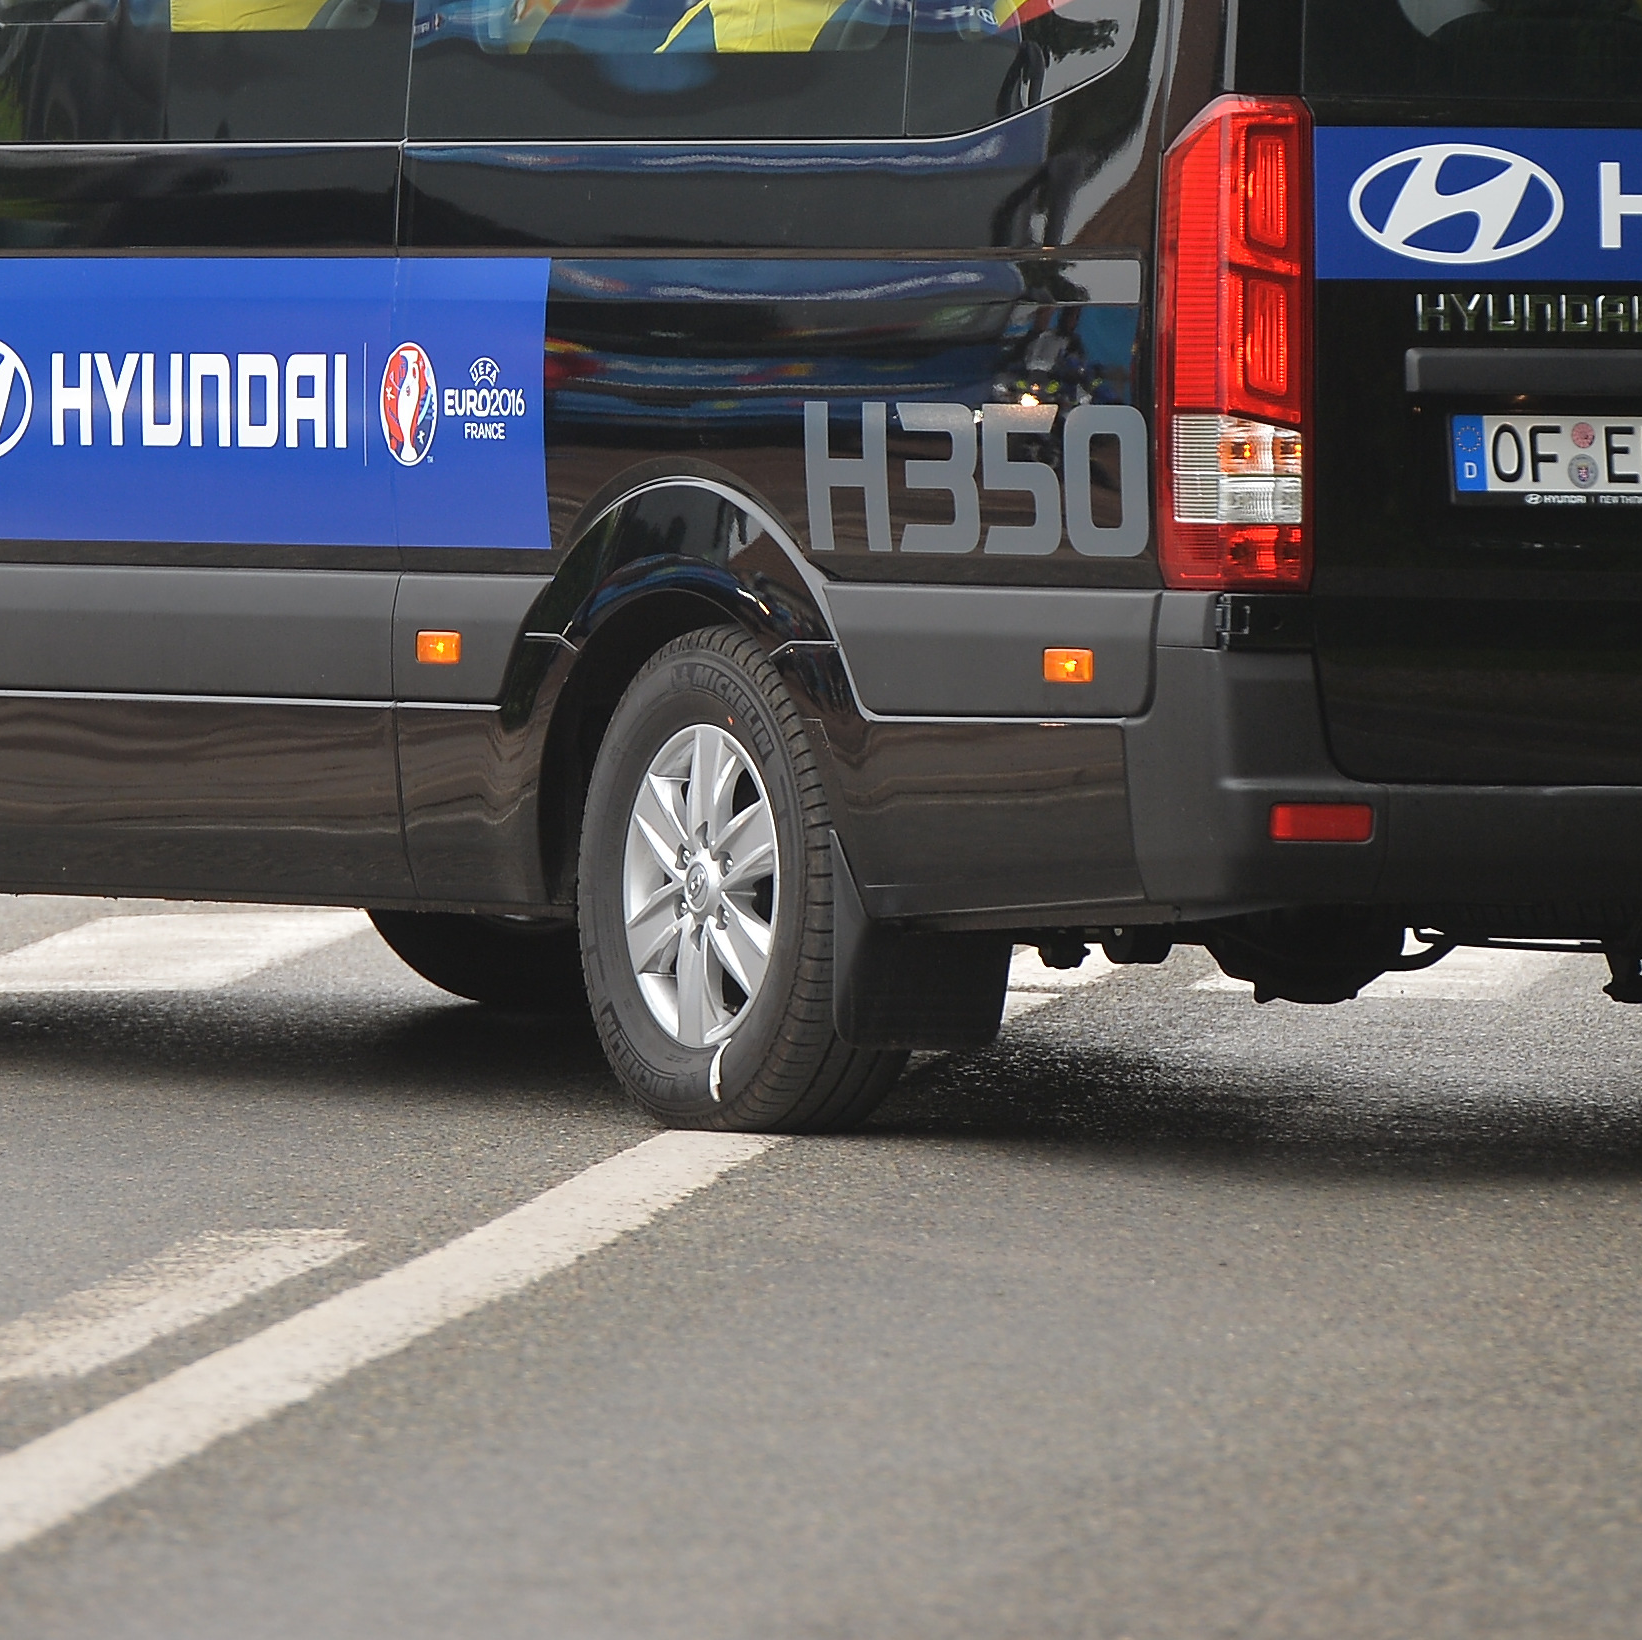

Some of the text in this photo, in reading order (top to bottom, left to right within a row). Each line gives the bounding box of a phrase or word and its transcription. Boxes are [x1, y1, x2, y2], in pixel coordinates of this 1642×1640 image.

[470, 361, 497, 383] UEFA
[51, 351, 347, 449] HYUNDAI
[444, 388, 525, 418] EURO2016
[464, 422, 506, 440] FRANCE
[1464, 462, 1477, 479] D
[1492, 423, 1561, 483] OF
[803, 400, 1149, 558] H350
[1544, 495, 1587, 504] HYUNDAI
[693, 667, 773, 753] MICHELIN
